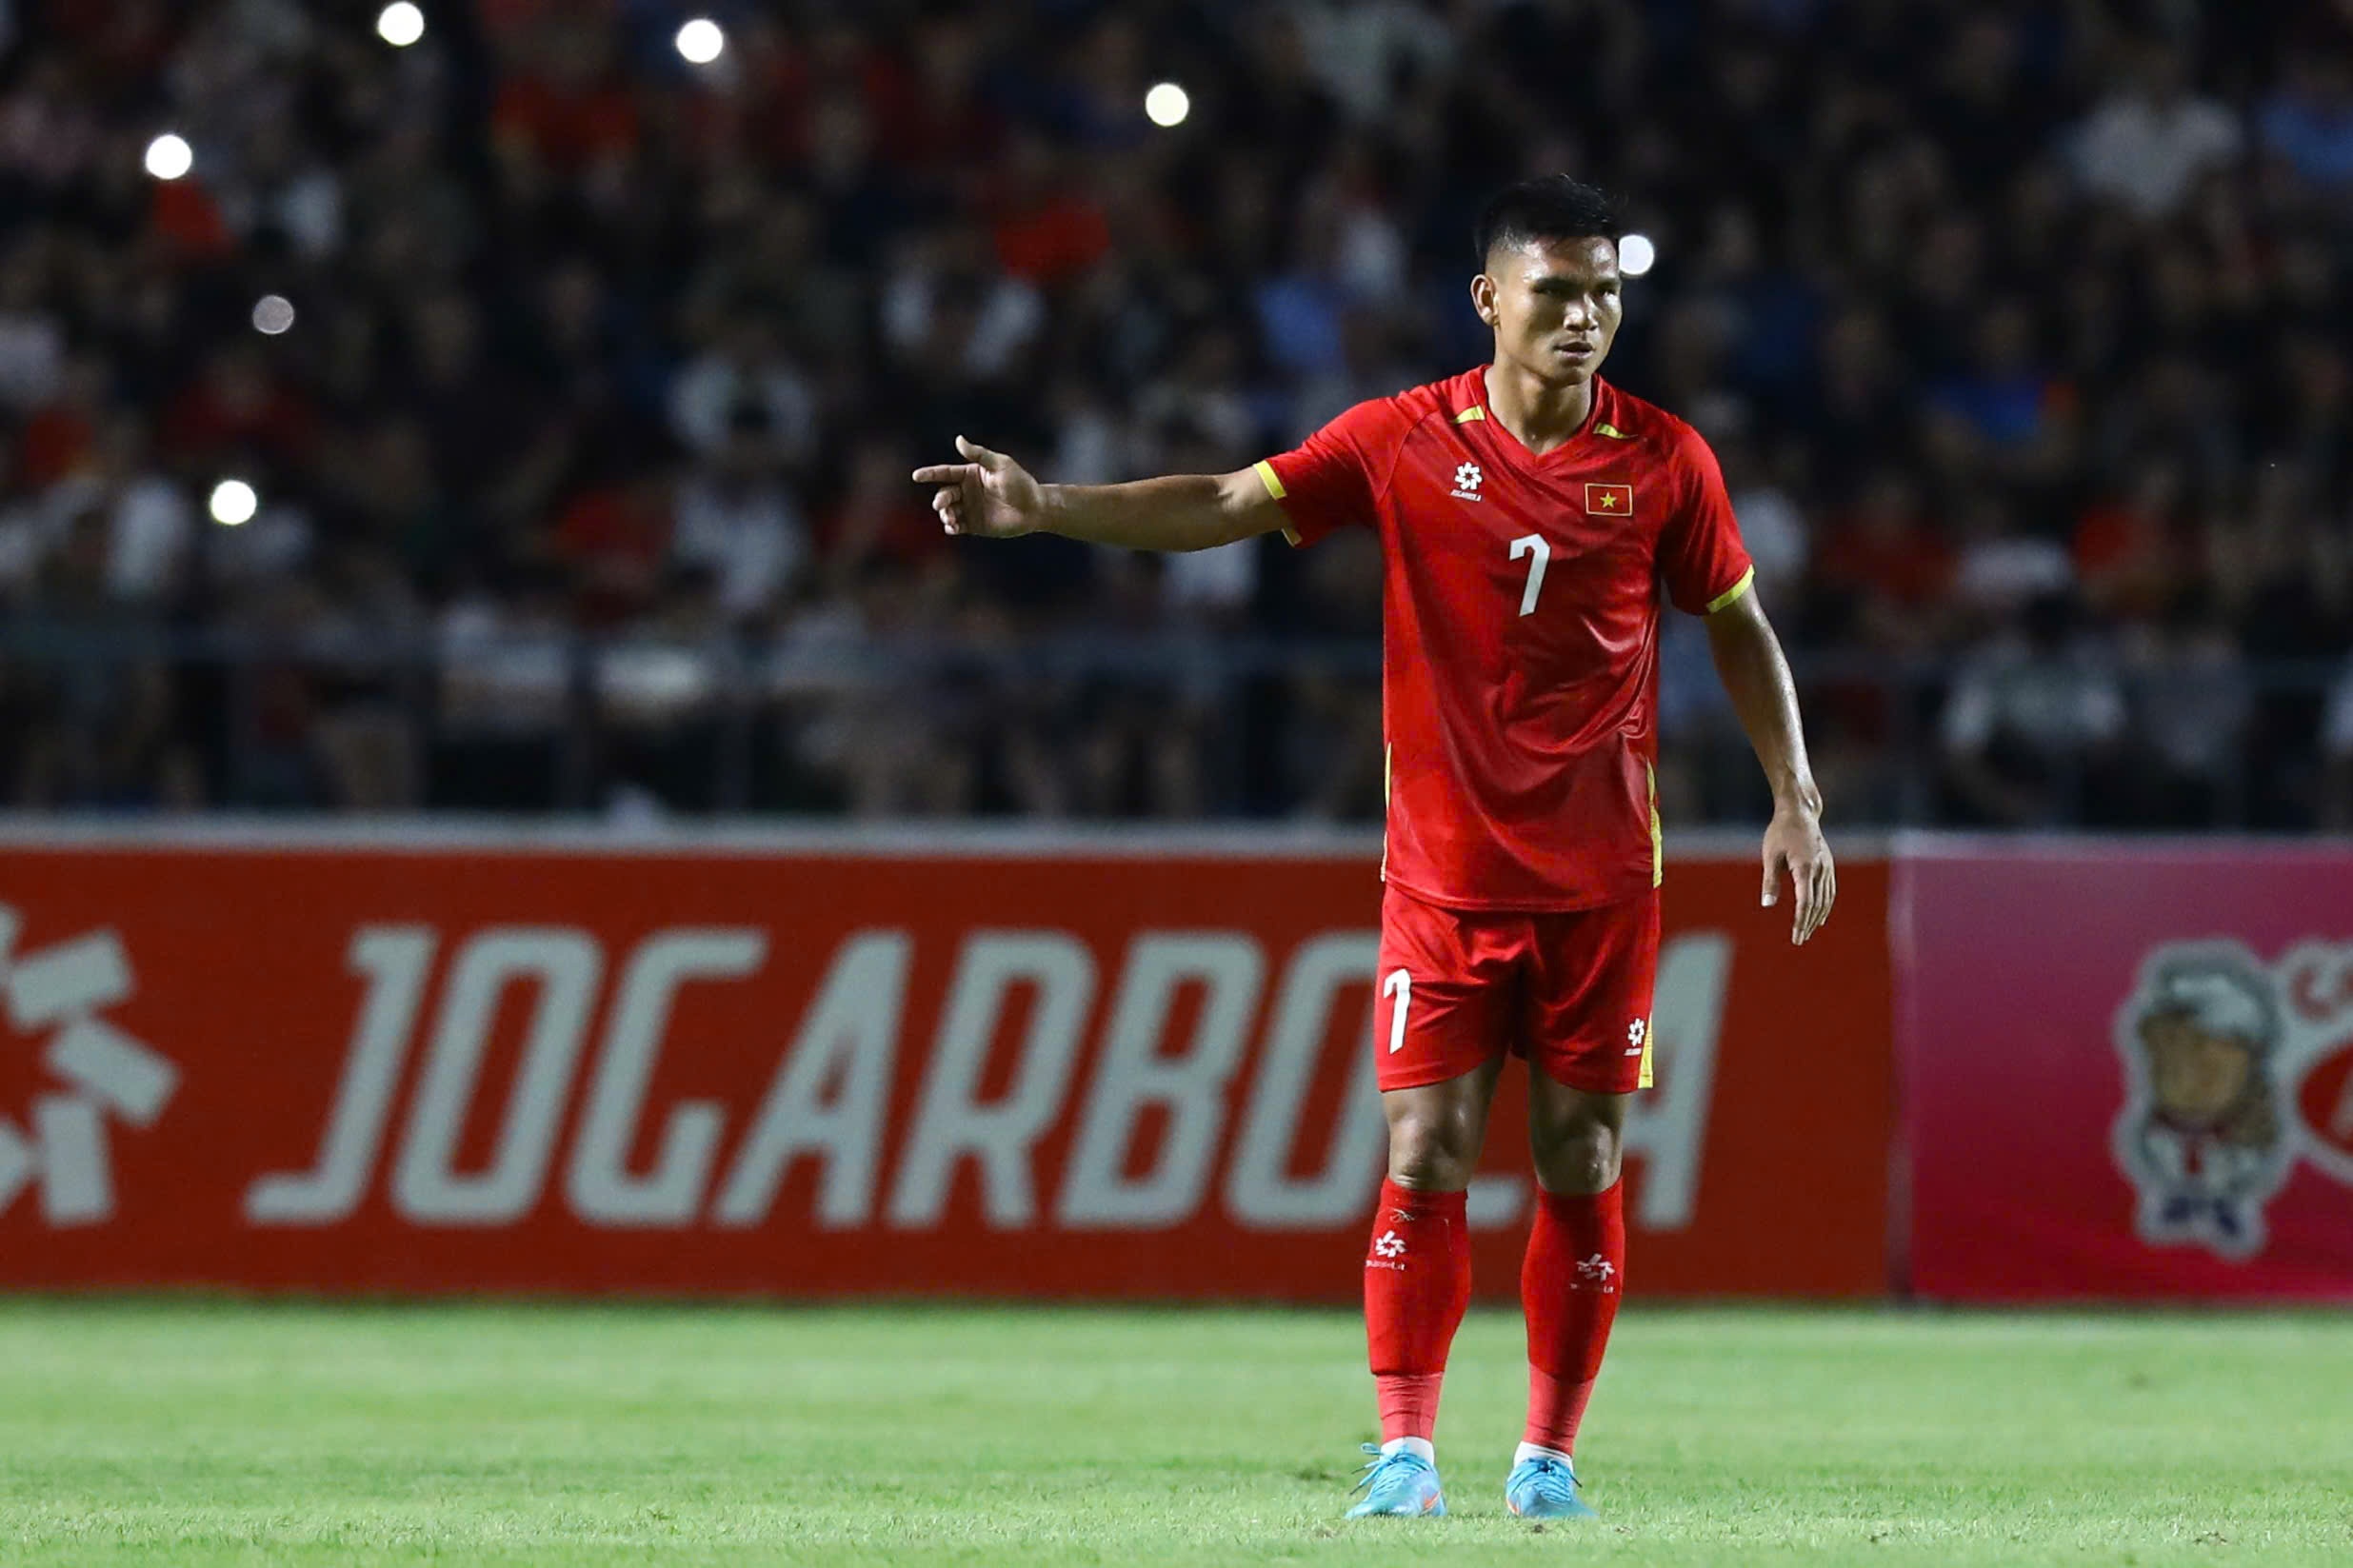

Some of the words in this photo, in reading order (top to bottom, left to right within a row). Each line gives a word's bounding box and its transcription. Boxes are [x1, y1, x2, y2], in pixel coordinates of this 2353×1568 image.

[1508, 533, 1550, 617] 7
[1383, 968, 1411, 1054] 7
[246, 926, 1731, 1228] JOGARBOA
